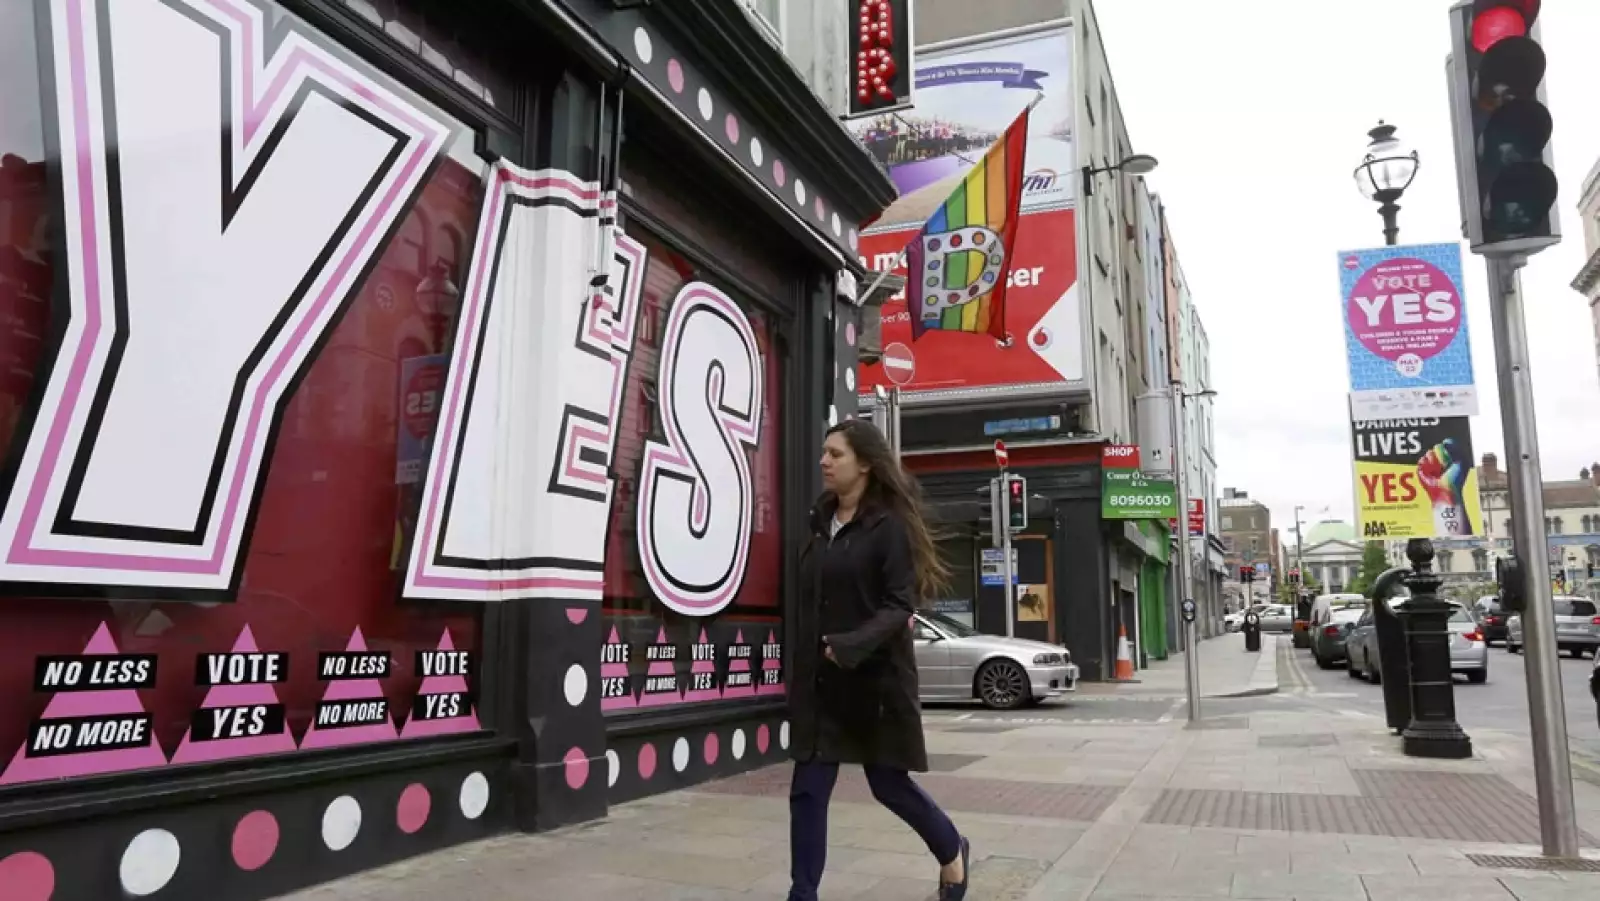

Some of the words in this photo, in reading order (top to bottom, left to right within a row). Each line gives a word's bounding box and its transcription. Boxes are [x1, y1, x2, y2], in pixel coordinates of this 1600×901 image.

[1372, 273, 1432, 290] VOTE
[0, 0, 764, 617] YES
[1354, 291, 1456, 327] YES
[1104, 446, 1134, 456] SHOP
[1357, 431, 1422, 456] LIVES
[1360, 472, 1418, 503] YES
[1110, 495, 1171, 506] 8096030
[647, 647, 658, 659] NO
[659, 646, 676, 659] LESS
[691, 643, 715, 660] VOTE
[762, 643, 781, 659] VOTE
[42, 661, 80, 686] NO
[89, 659, 151, 684] LESS
[208, 654, 279, 683] VOTE
[322, 657, 347, 676] NO
[350, 656, 387, 675] LESS
[421, 651, 468, 676] VOTE
[602, 677, 624, 698] YES
[646, 679, 656, 691] NO
[656, 677, 676, 690] MORE
[694, 673, 713, 690] YES
[764, 669, 779, 684] YES
[318, 706, 342, 725] NO
[344, 701, 386, 722] MORE
[424, 694, 460, 718] YES
[211, 706, 267, 738] YES
[33, 725, 74, 751] NO
[76, 719, 147, 747] MORE
